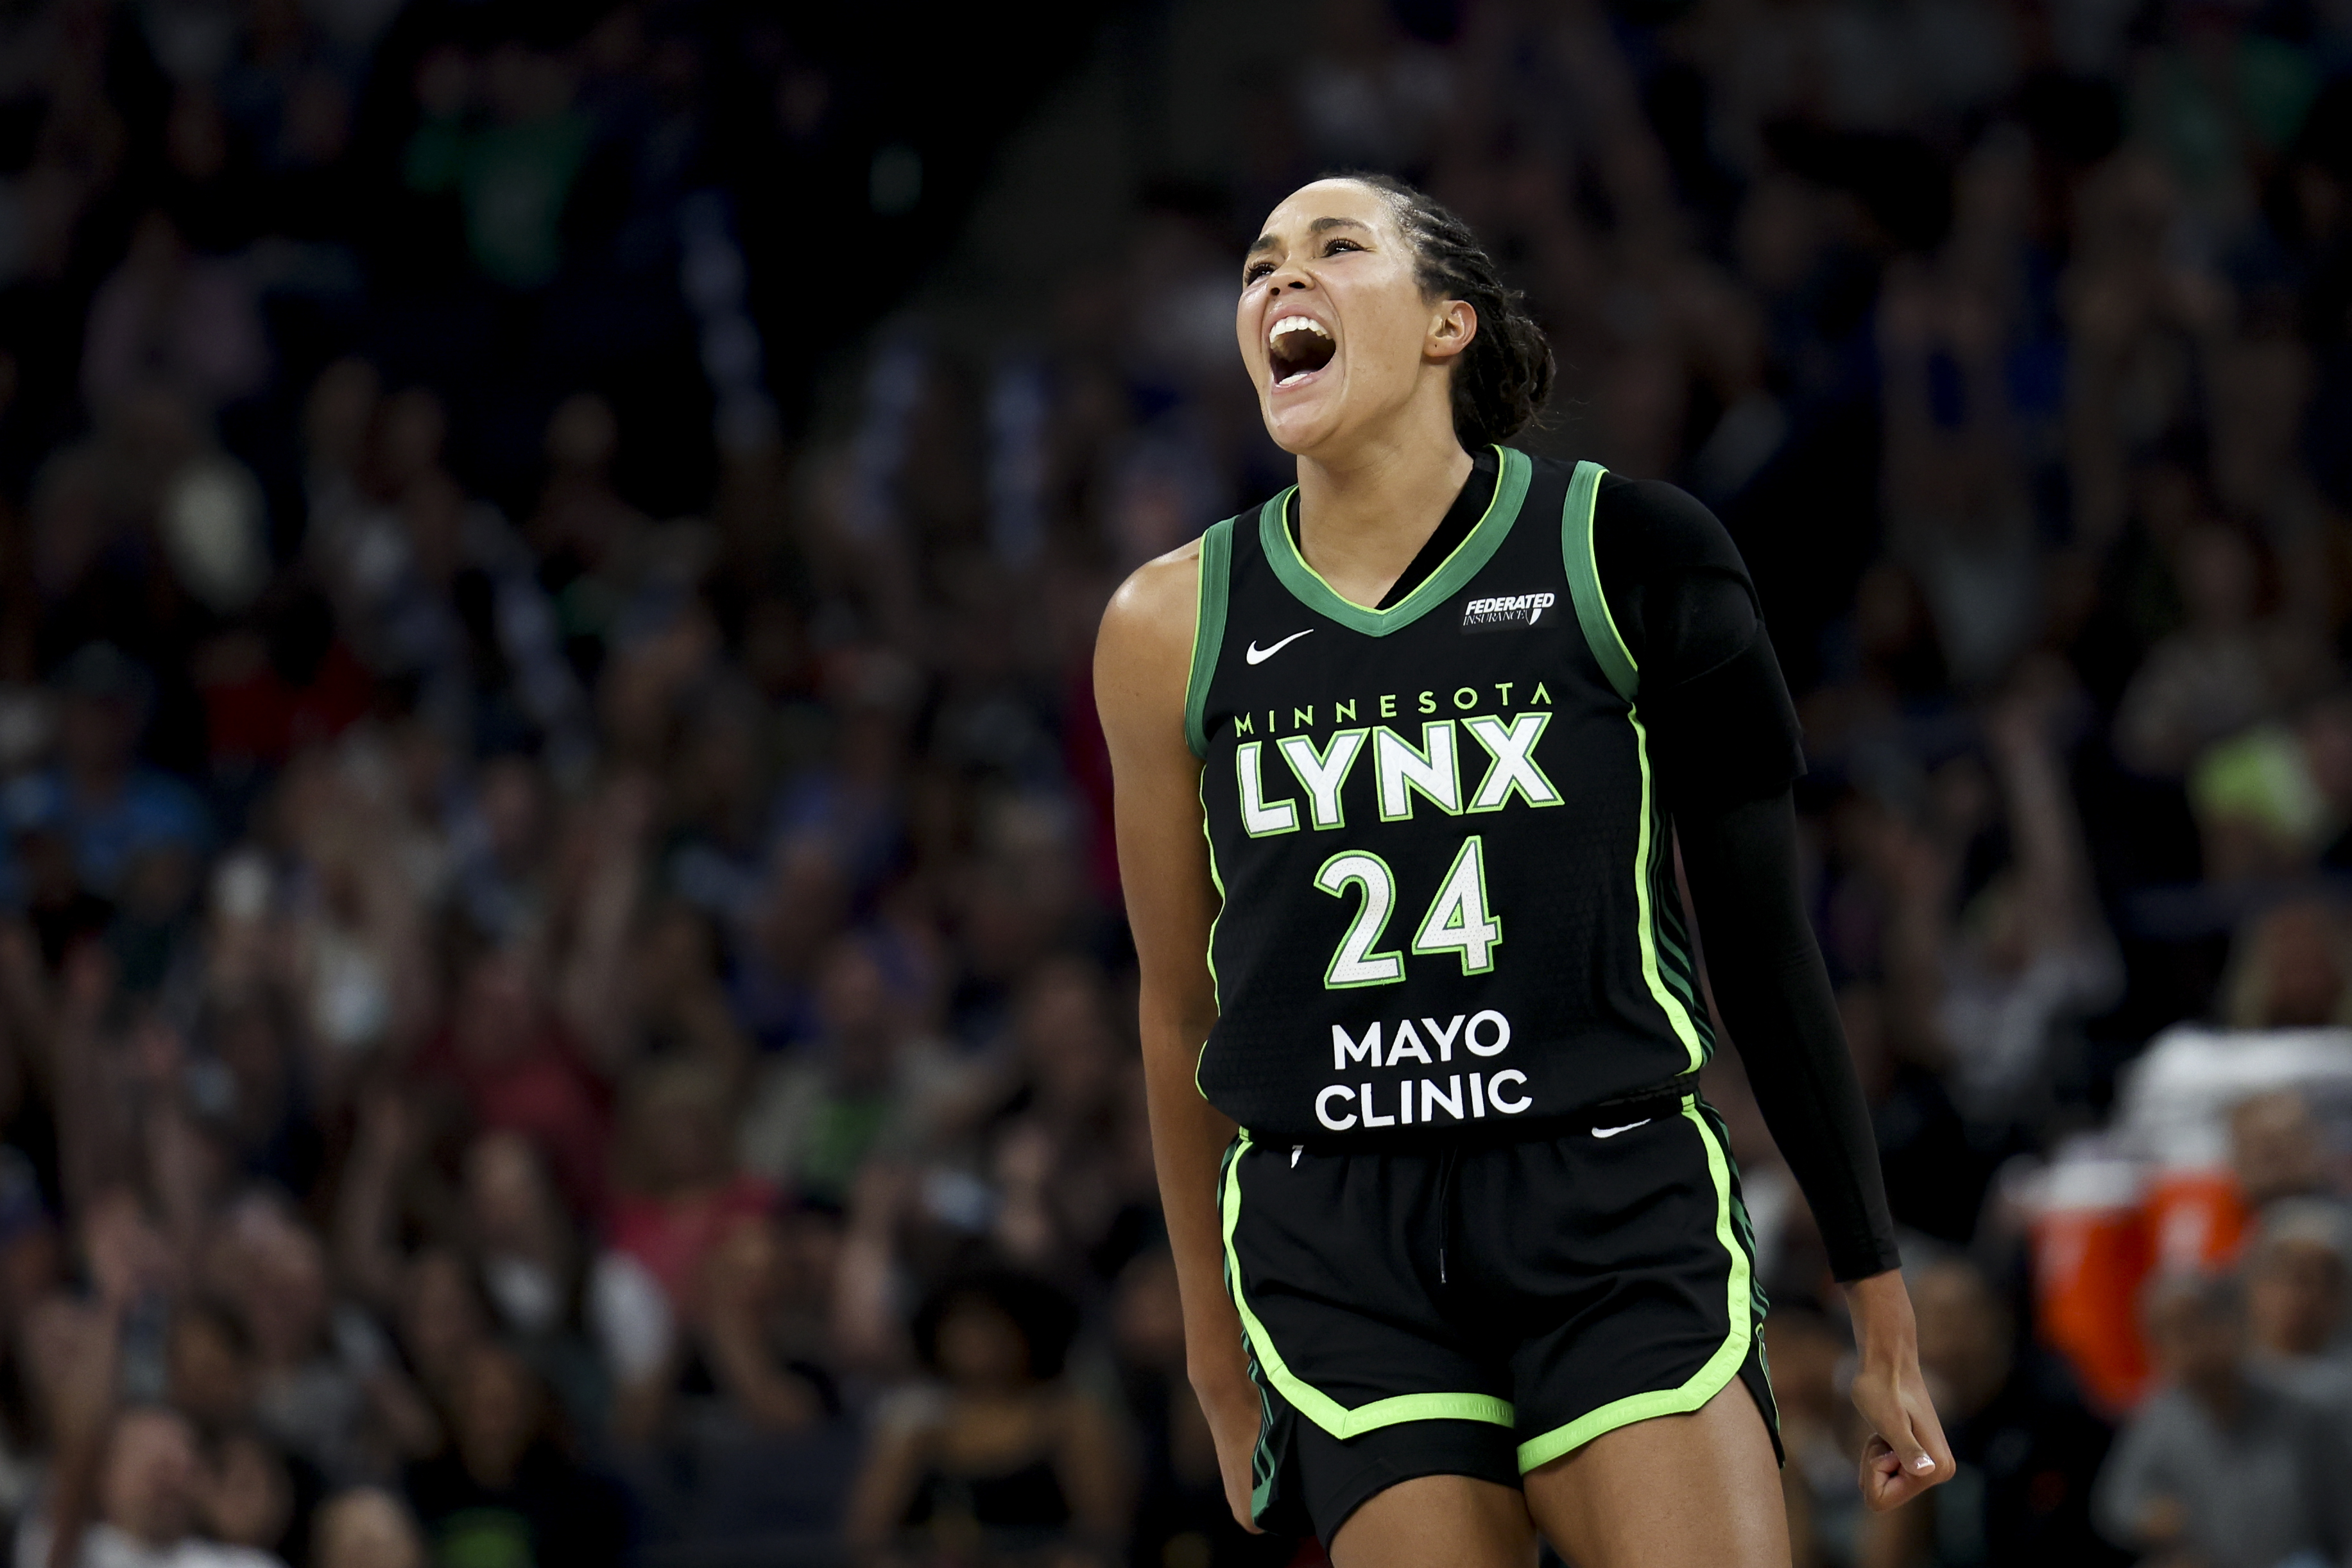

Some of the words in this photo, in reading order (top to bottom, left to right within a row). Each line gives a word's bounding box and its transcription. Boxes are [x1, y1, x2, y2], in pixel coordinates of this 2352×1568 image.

[1463, 609, 1526, 626] INSURANCE
[1466, 593, 1555, 616] FEDERATED
[1235, 682, 1552, 738] MINNESOTA
[1236, 711, 1565, 839] LYNX
[1313, 835, 1503, 990] 24
[1332, 1010, 1511, 1070] MAYO
[1315, 1069, 1532, 1131] CLINIC
